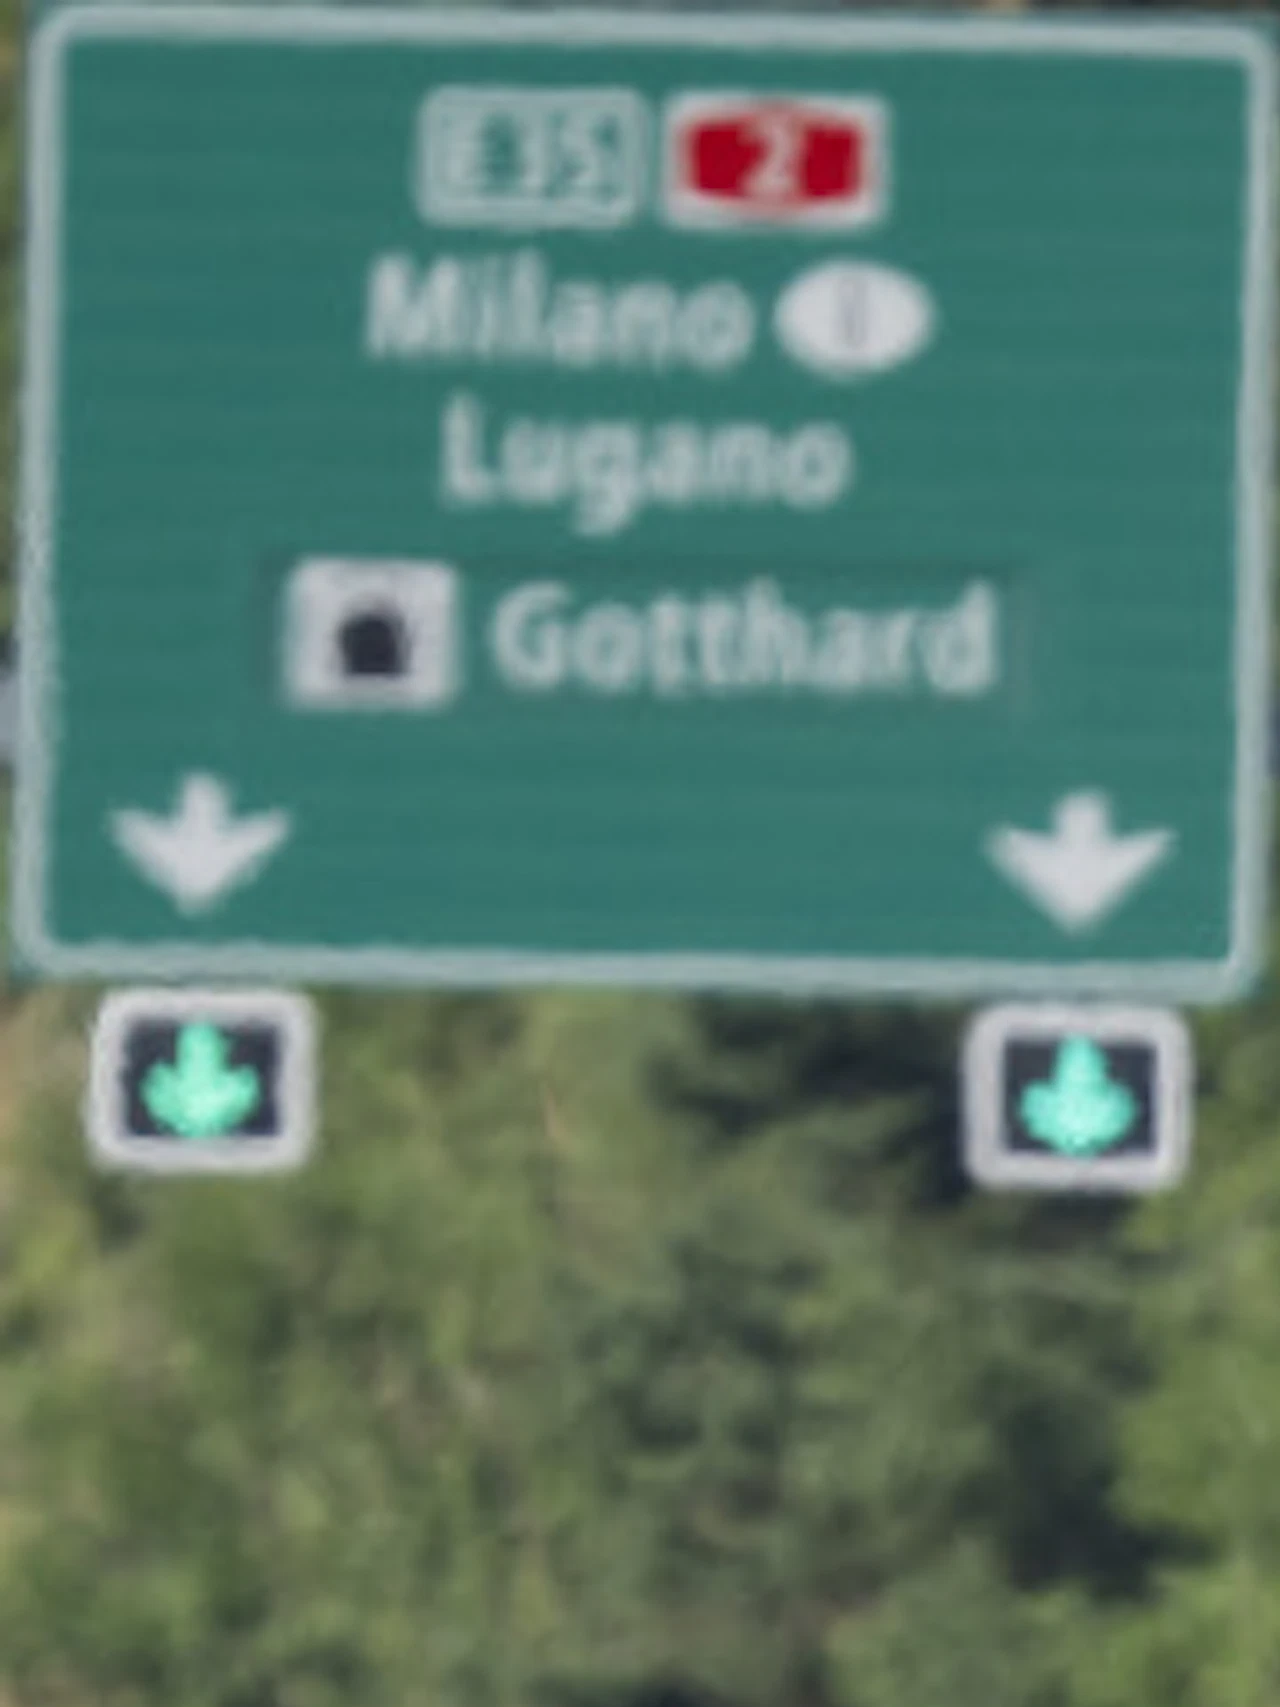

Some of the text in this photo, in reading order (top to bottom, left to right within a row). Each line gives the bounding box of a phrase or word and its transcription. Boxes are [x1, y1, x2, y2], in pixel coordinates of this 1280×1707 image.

[742, 110, 804, 202] 2
[368, 252, 757, 368] Milano
[442, 392, 851, 538] Lugano
[490, 579, 996, 693] Gotthard
